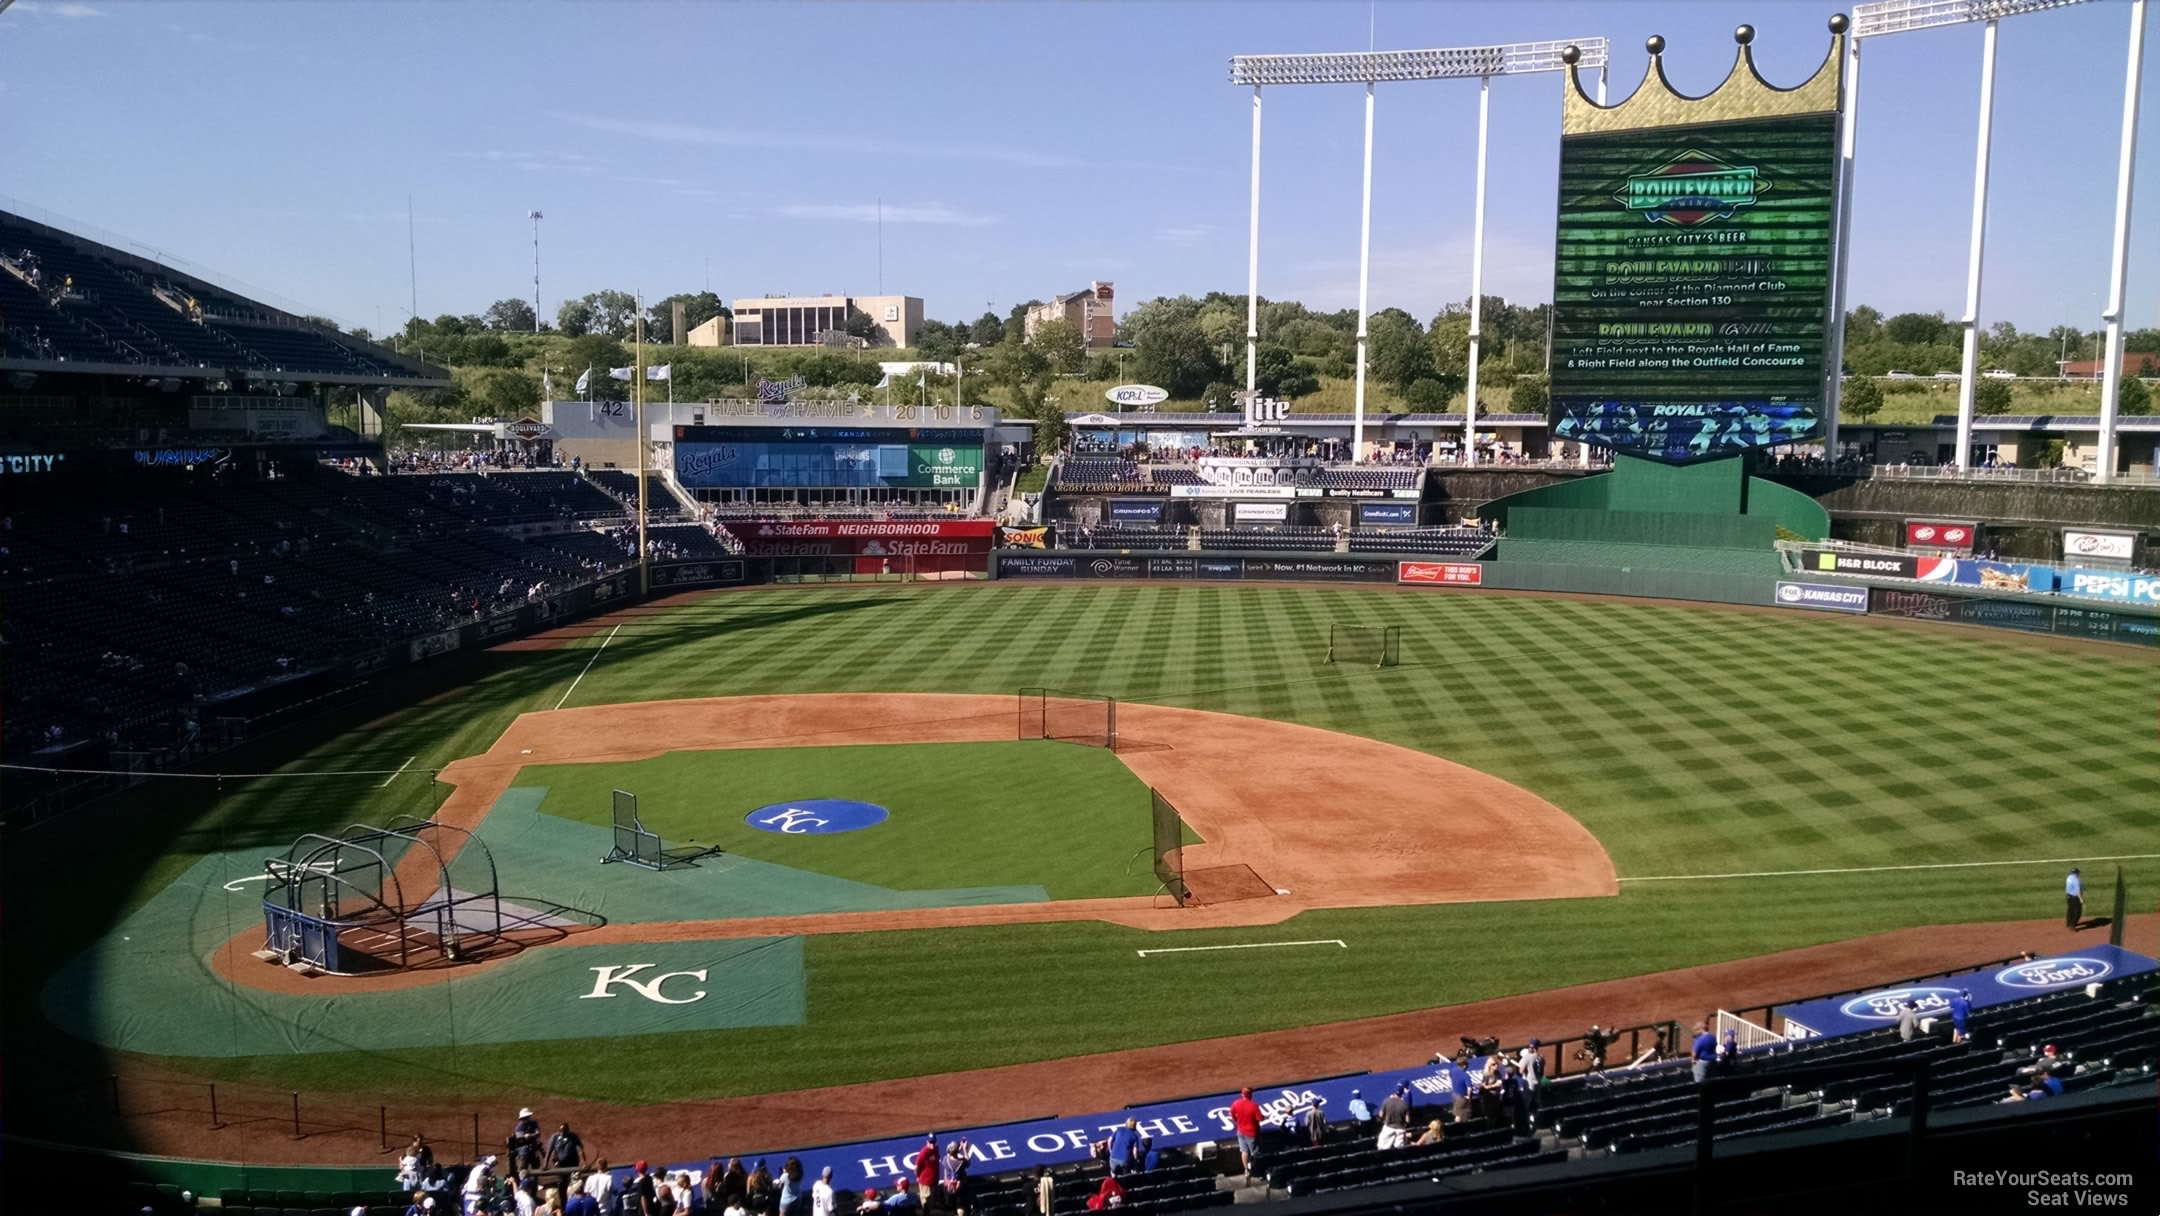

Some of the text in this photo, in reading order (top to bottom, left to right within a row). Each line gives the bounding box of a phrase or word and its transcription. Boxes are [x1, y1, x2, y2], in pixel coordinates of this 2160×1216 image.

[1634, 174, 1750, 204] BOULEVARD
[1628, 231, 1747, 248] KANSAS CITY'S BEER
[1606, 260, 1721, 285] BOULEVARD
[1591, 288, 1607, 299] On
[1630, 287, 1665, 297] corner
[1668, 284, 1680, 295] of
[1683, 284, 1700, 294] the
[1704, 282, 1756, 293] Diamond
[1759, 280, 1786, 291] Club
[1639, 295, 1732, 308] near Section 130
[1598, 322, 1714, 346] BOULEVARD
[1572, 342, 1801, 357] Left Field next to the Royals Hall of Fame
[1567, 355, 1804, 370] & Right Field along the Outfield Concourse
[756, 373, 807, 401] Royals
[600, 401, 624, 417] 42
[708, 398, 855, 421] HALL of FAME
[895, 403, 917, 420] 20
[932, 403, 951, 421] 10
[972, 404, 984, 421] 5
[1653, 404, 1707, 418] ROYAL
[511, 424, 547, 433] BOULEVARD
[11, 454, 55, 474] CITY
[680, 445, 737, 477] Royals
[917, 464, 976, 474] Commerce
[933, 474, 961, 485] Bank
[1086, 485, 1116, 493] CASINO
[1118, 485, 1146, 493] HOTEL
[1329, 489, 1351, 497] Quality
[1352, 489, 1384, 497] Healthcare
[838, 524, 940, 535] NEIGHBORHOOD
[1006, 532, 1045, 543] SONIC
[1020, 566, 1059, 574] SUNDAY
[1306, 564, 1342, 572] Network
[1353, 565, 1366, 573] KC
[1837, 557, 1901, 572] H&R BLOCK
[2073, 573, 2130, 598] PEPSI
[1803, 590, 1842, 602] KANSAS
[1842, 592, 1865, 604] CITY
[760, 807, 829, 835] KC
[2017, 962, 2098, 986] Ford
[578, 962, 709, 1005] KC
[1026, 1128, 1089, 1153] OF
[1098, 1114, 1200, 1140] THE
[1207, 1089, 1328, 1131] Ryals
